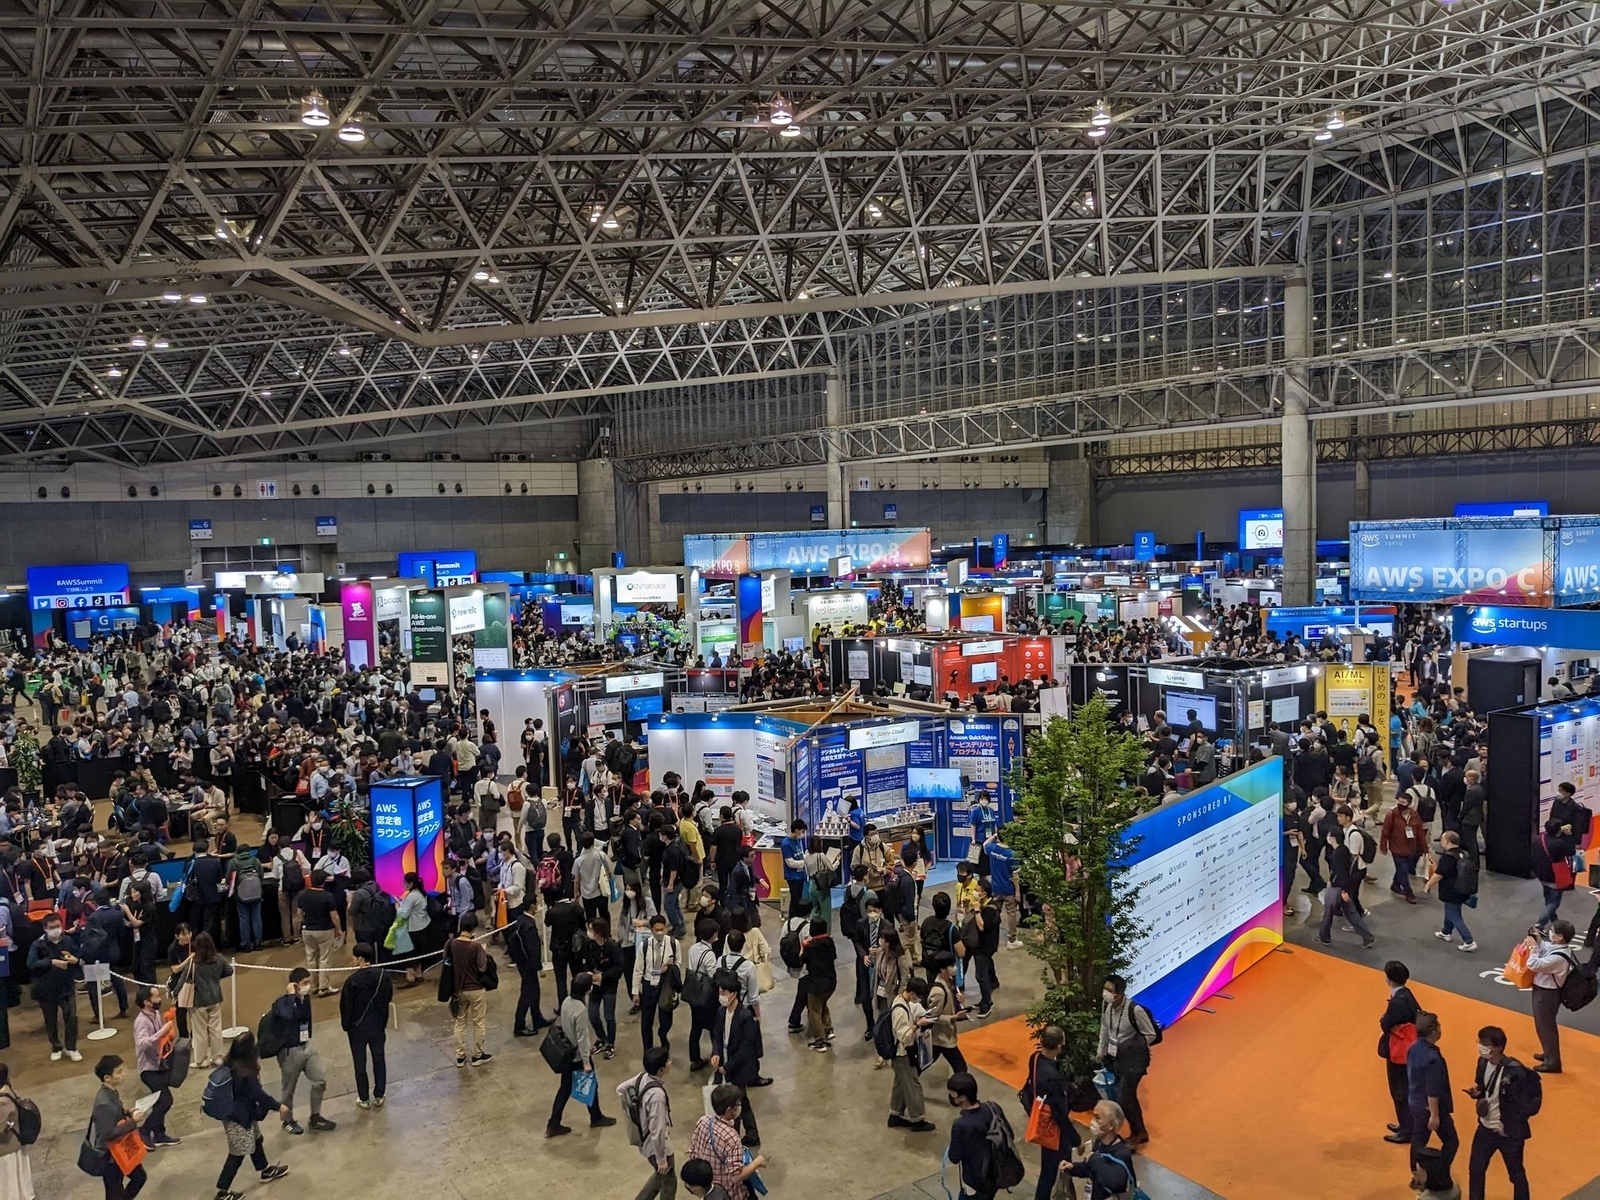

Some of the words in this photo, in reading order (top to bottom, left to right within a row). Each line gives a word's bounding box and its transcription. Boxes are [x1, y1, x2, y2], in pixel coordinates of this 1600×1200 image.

[1142, 536, 1148, 544] D
[1362, 534, 1379, 542] aws
[786, 545, 829, 564] AWS
[834, 542, 884, 562] EXPO
[889, 541, 900, 558] B
[420, 566, 425, 574] F
[712, 560, 732, 571] EXPO
[734, 560, 740, 571] B
[56, 578, 103, 586] #AWSSummit
[1366, 566, 1423, 588] AWS
[1432, 567, 1507, 589] EXPO
[1518, 568, 1534, 590] C
[1564, 565, 1598, 589] AWS
[634, 582, 666, 590] dynatrace
[527, 591, 532, 600] F
[99, 616, 108, 625] G
[1472, 617, 1495, 627] aws
[1498, 618, 1548, 632] startups
[376, 804, 398, 812] AWS
[418, 799, 431, 812] AWS
[1177, 799, 1220, 826] SPONSORED
[1224, 794, 1231, 804] BY
[376, 816, 402, 825] 認定者
[418, 810, 434, 824] 認定者
[377, 828, 410, 838] ラウンジ
[418, 821, 440, 837] ラウンジ
